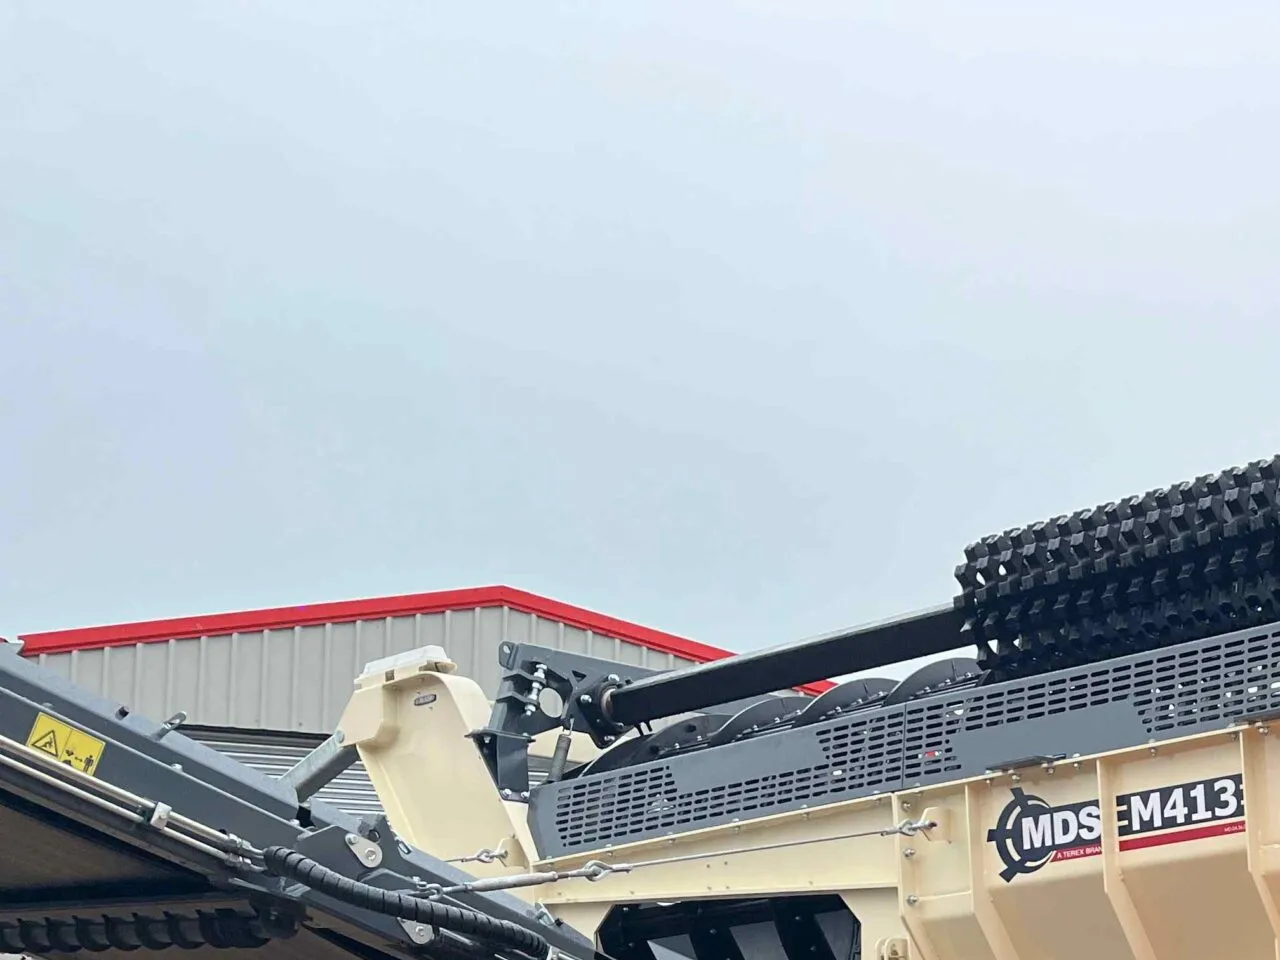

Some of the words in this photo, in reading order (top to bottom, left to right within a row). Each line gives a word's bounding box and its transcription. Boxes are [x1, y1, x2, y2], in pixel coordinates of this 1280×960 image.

[1021, 805, 1102, 850] MDS
[1130, 779, 1238, 831] M413
[1063, 849, 1085, 858] TEREX
